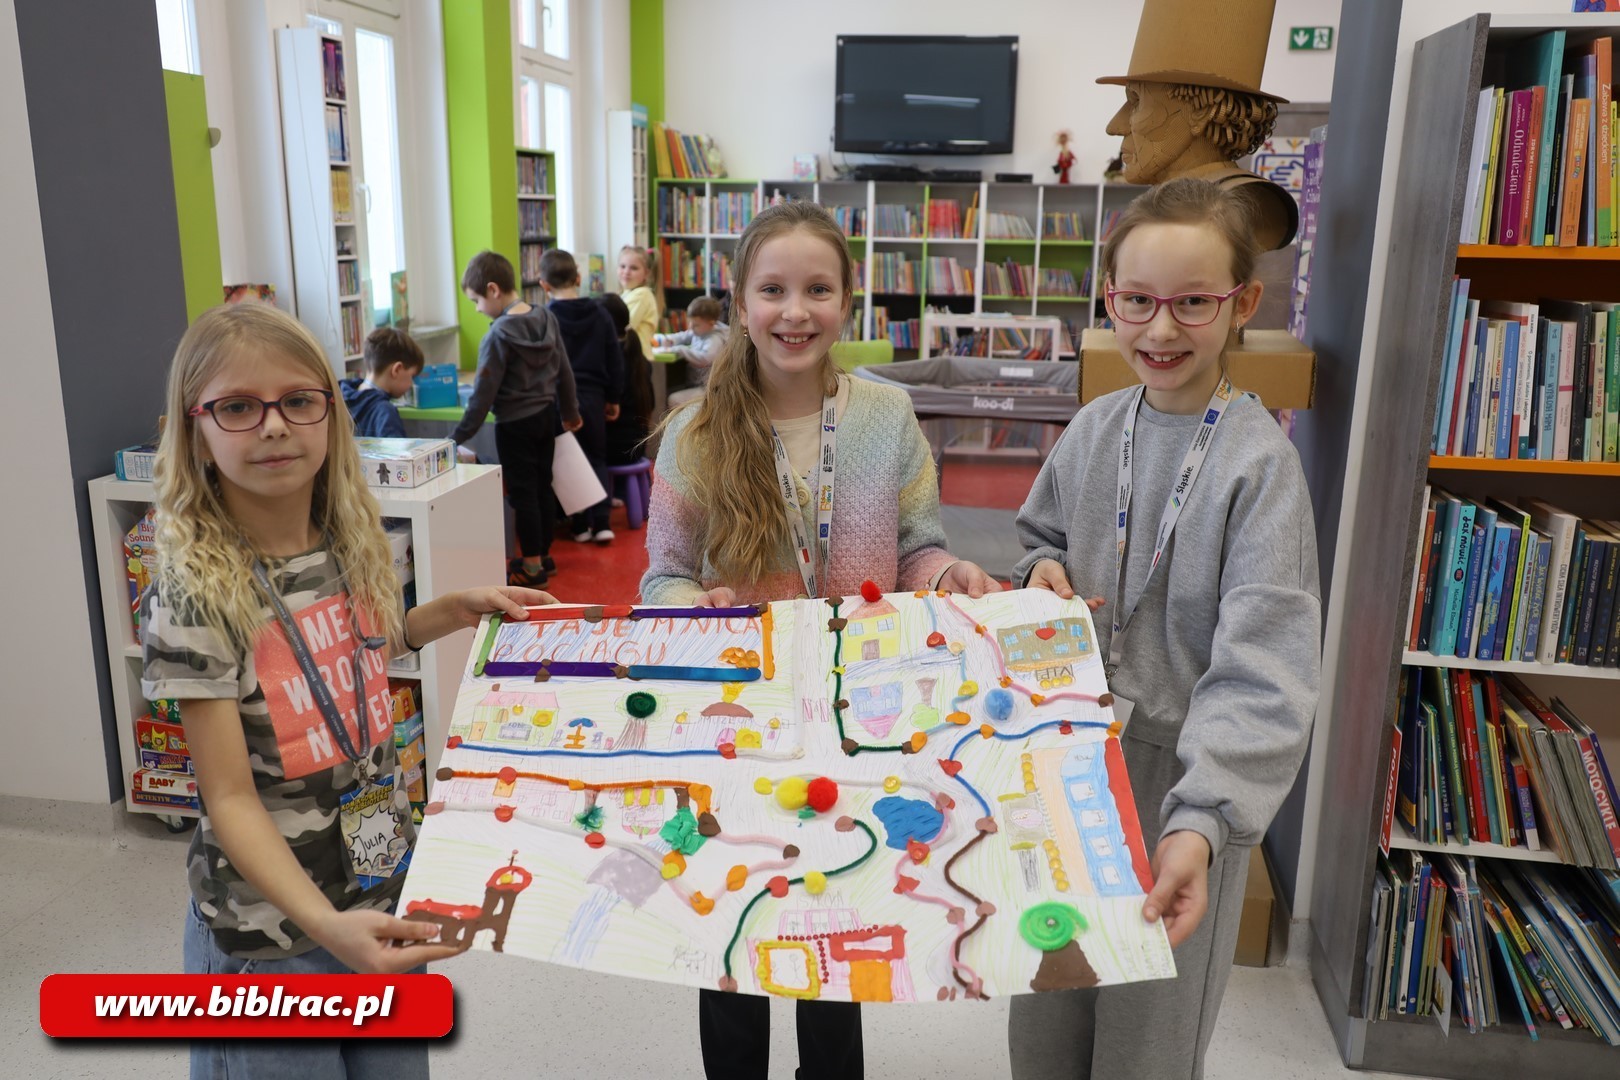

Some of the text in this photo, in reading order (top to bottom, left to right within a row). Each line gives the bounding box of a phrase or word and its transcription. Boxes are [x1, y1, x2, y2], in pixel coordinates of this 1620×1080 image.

[1601, 84, 1611, 117] Zabawa
[1601, 124, 1609, 164] dzieckiem
[1508, 129, 1525, 195] Odnalezieni
[973, 396, 1015, 411] koo-di
[1122, 440, 1131, 470] Śląskie.
[782, 472, 793, 499] Śląskie.
[1176, 464, 1194, 495] Śląskie.
[1457, 536, 1468, 565] mówić
[530, 615, 761, 640] TAJEMNICA
[282, 648, 384, 716] WRONG
[306, 688, 394, 763] NVER
[136, 793, 171, 803] DETEKTYW
[149, 777, 175, 788] BABY
[1384, 747, 1397, 825] POJAZDY
[1582, 750, 1617, 830] MOTOCYKLE
